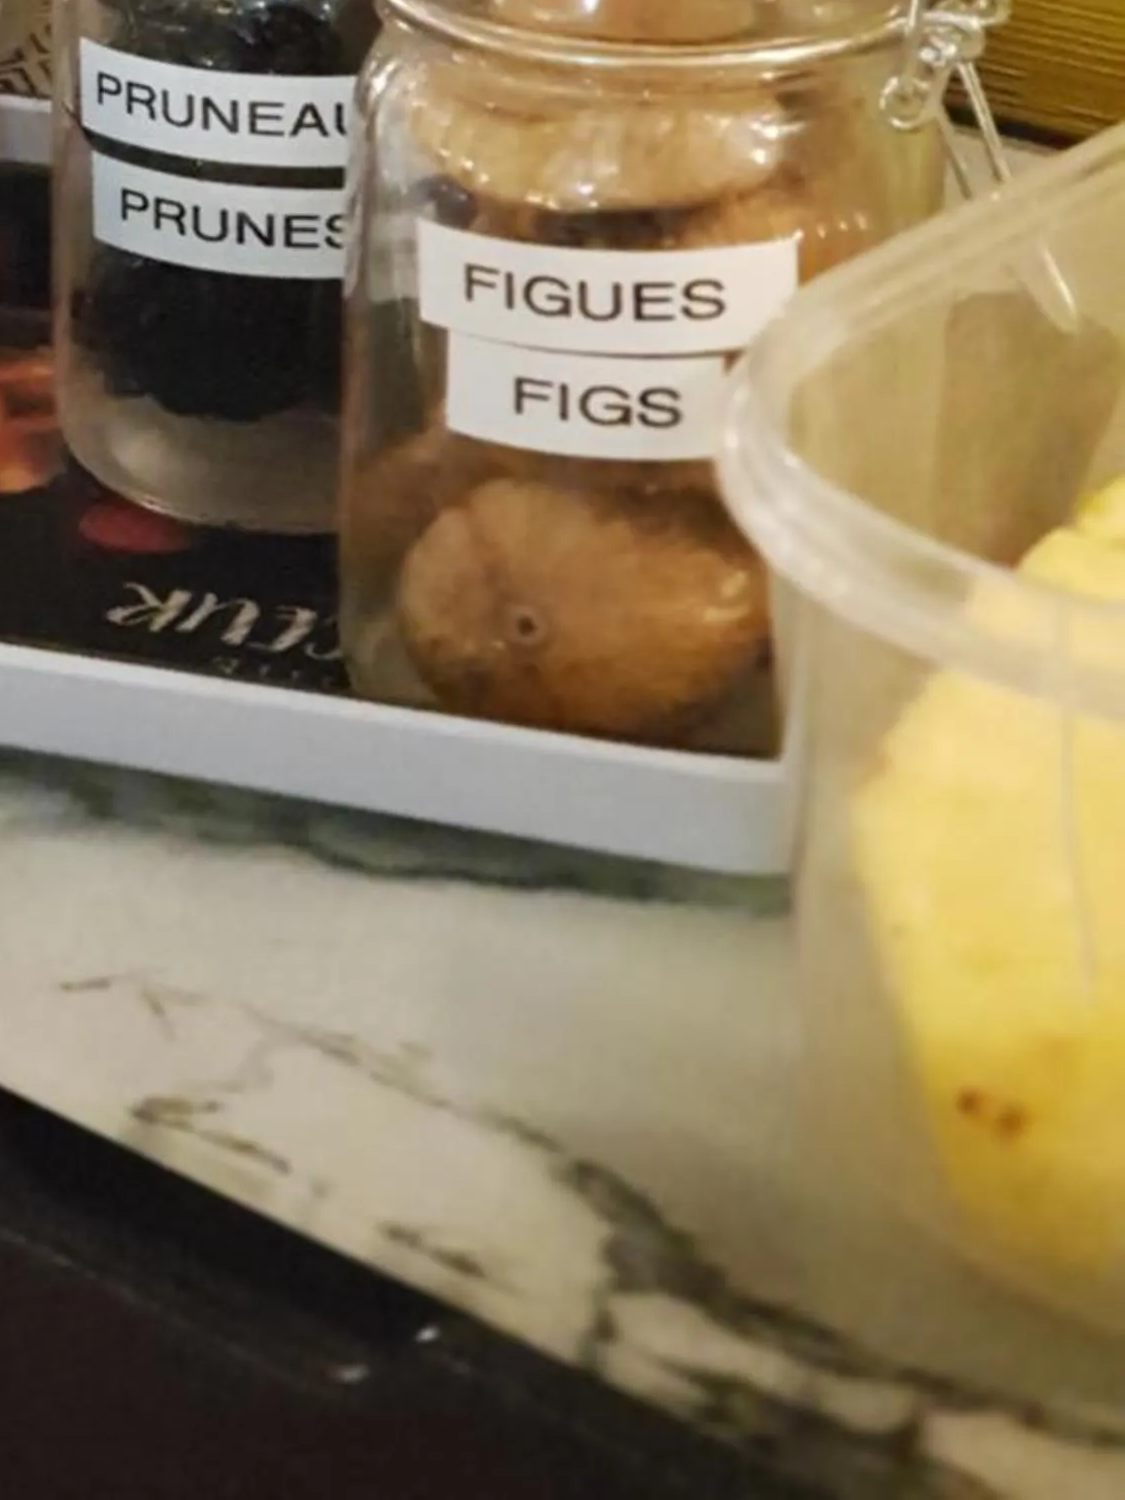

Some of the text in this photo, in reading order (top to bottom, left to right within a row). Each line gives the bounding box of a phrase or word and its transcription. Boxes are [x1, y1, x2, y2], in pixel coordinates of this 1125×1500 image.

[120, 186, 345, 250] PRUNES
[463, 261, 727, 322] FIGUES
[513, 375, 683, 428] FIGS
